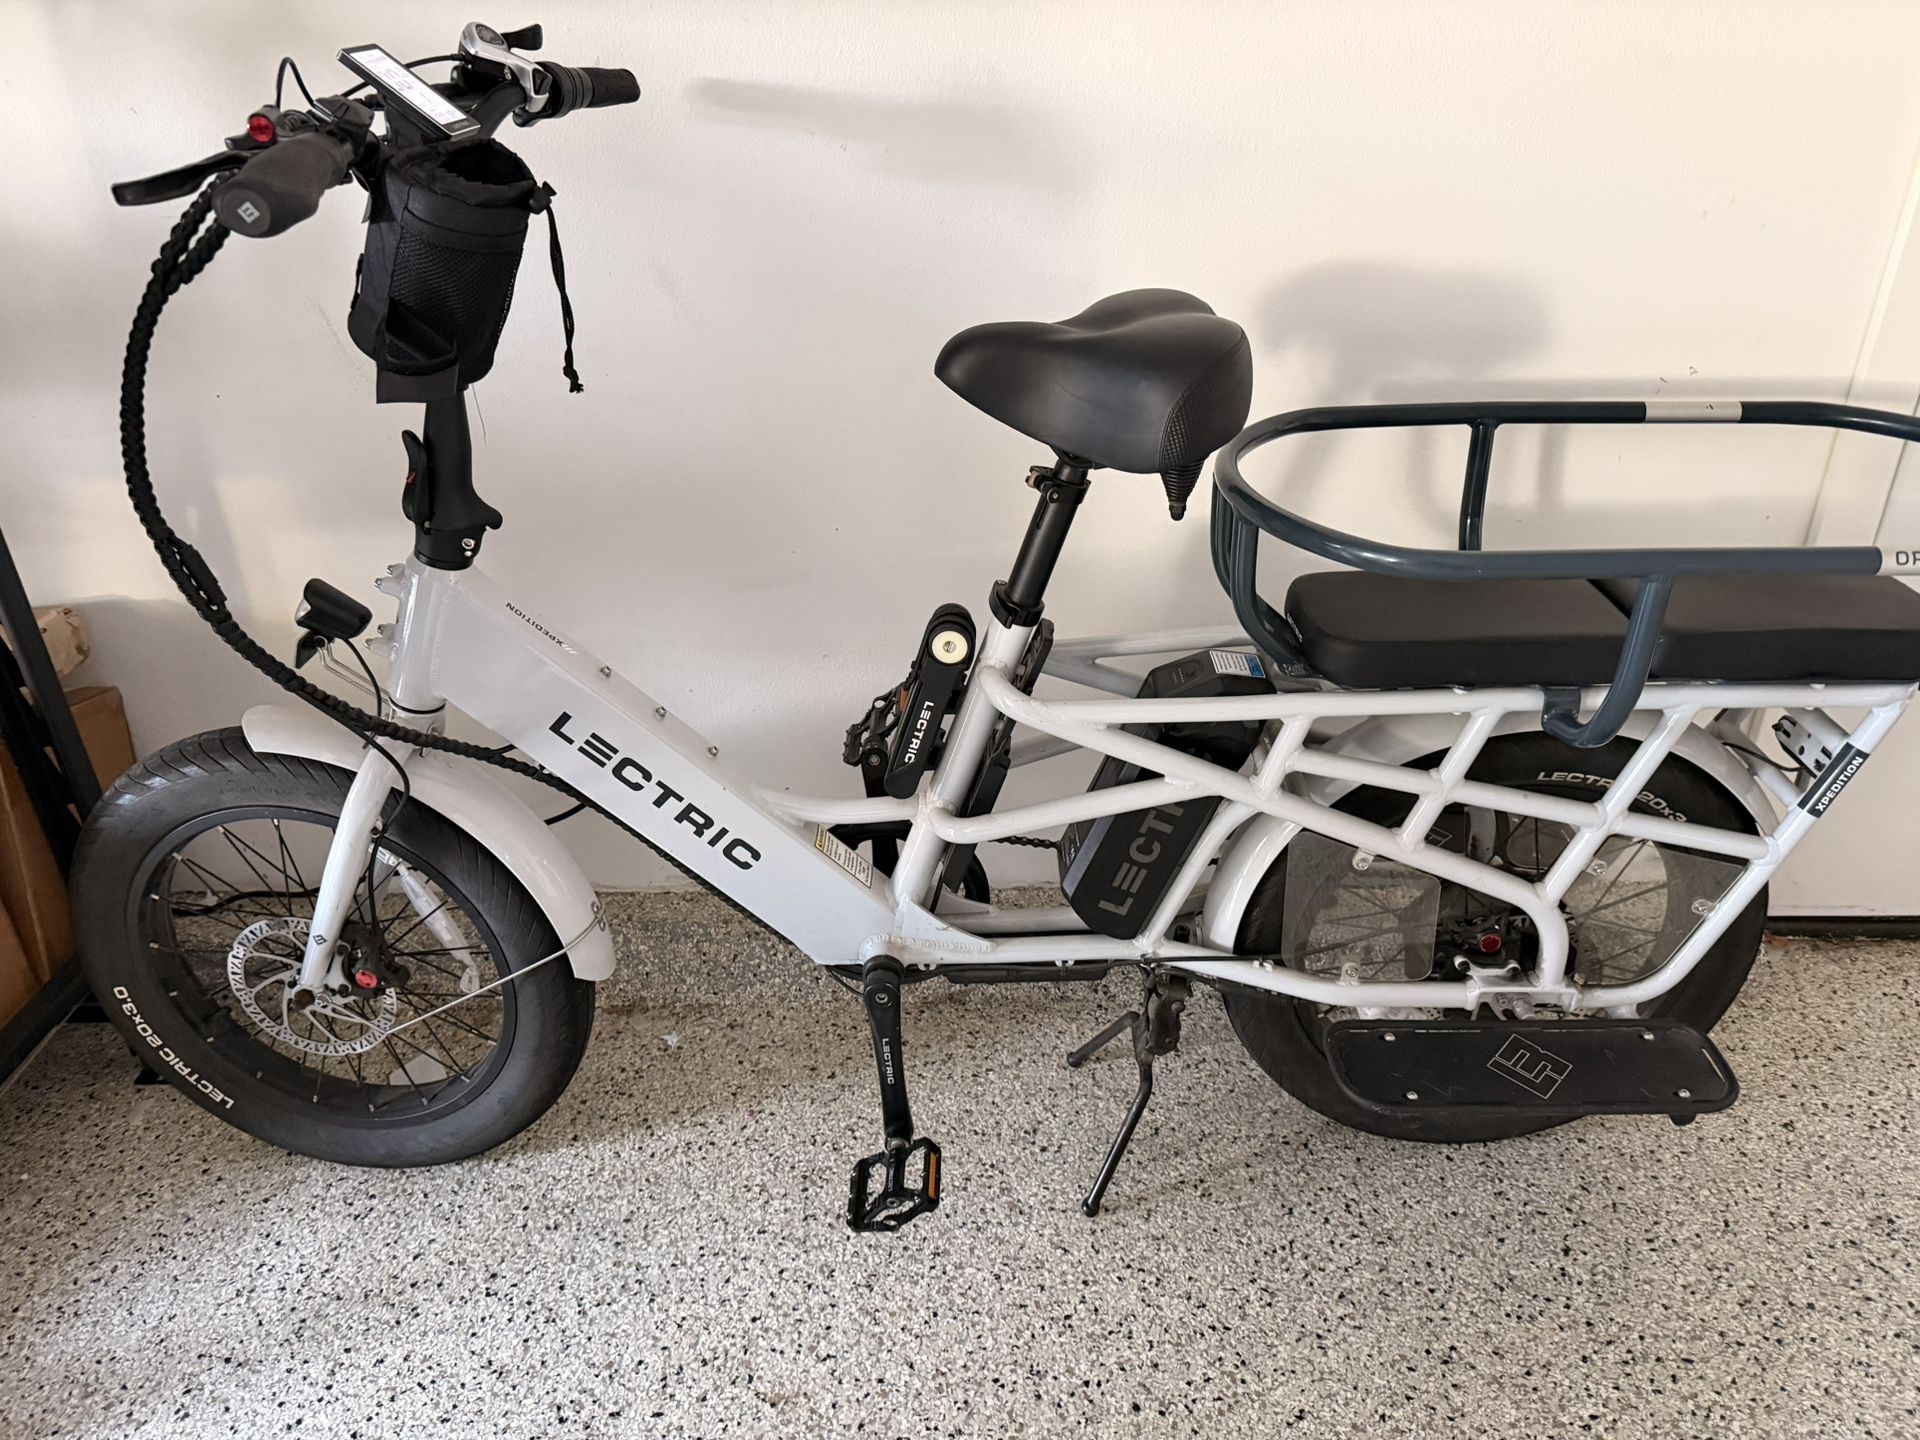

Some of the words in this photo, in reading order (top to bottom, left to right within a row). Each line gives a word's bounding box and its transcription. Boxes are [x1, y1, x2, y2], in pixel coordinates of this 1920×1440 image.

[505, 602, 564, 647] XPEDITION
[904, 700, 935, 764] LECTRIC
[548, 711, 761, 870] LECTRIC
[1537, 771, 1616, 788] LECTR
[1815, 756, 1864, 812] XPEDITION
[1098, 799, 1190, 916] LECT
[113, 986, 163, 1047] 20x3.0
[158, 1047, 235, 1109] LECTRIC
[881, 1038, 895, 1085] LECTRIC
